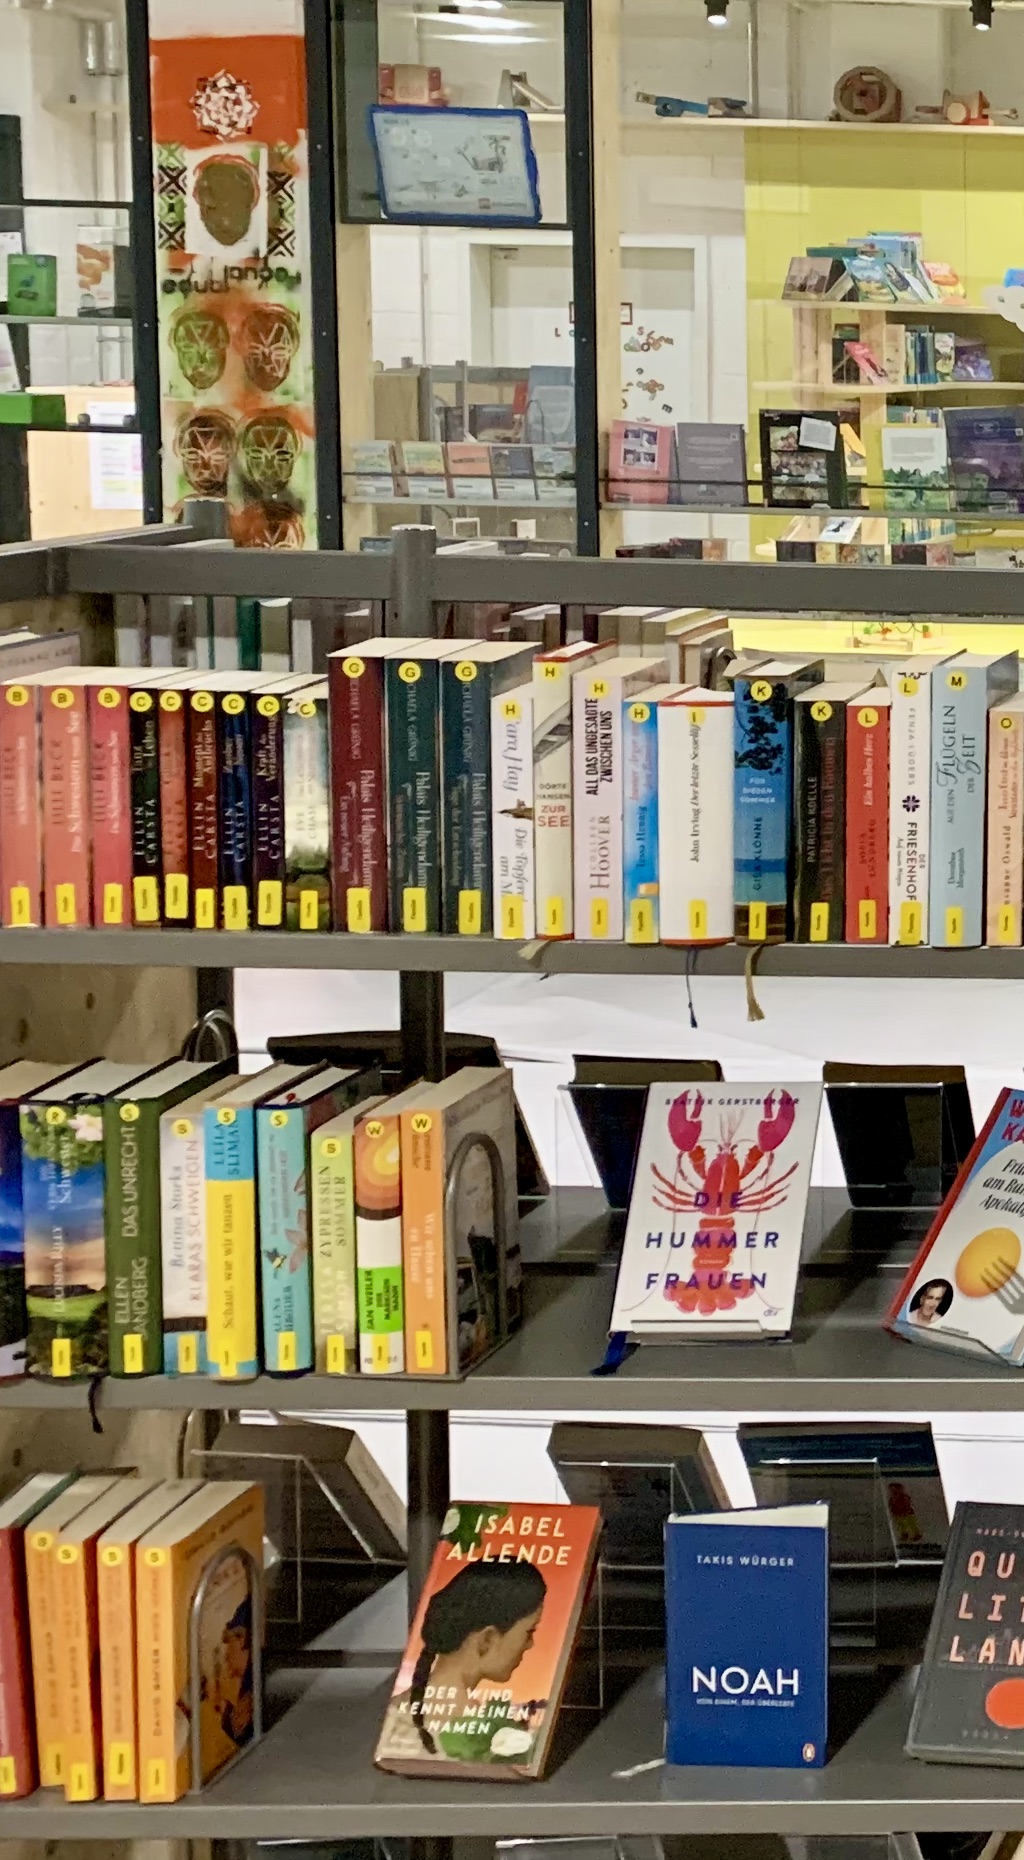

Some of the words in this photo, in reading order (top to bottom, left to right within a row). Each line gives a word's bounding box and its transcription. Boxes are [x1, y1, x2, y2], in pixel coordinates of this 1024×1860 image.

[756, 686, 766, 696] K
[904, 683, 912, 694] L
[950, 676, 962, 687] M
[600, 711, 613, 731] UNS
[816, 706, 826, 716] K
[864, 714, 872, 724] L
[584, 698, 598, 754] UNGESAGTE
[935, 705, 957, 787] FLÜGELN
[954, 733, 981, 774] ZEIT
[586, 757, 598, 775] DAS
[600, 733, 613, 783] ZWISCHEN
[585, 780, 598, 795] ALL
[540, 805, 565, 813] ZUR
[145, 798, 156, 864] CARSTA
[205, 794, 216, 859] CARSTA
[269, 795, 280, 859] CARSTA
[538, 815, 570, 828] SEE
[690, 808, 701, 836] Irving
[690, 839, 700, 862] John
[807, 817, 817, 862] PATRICIA
[589, 815, 610, 889] HOOVER
[906, 822, 918, 901] FRIESENHOF
[413, 1115, 430, 1132] W
[120, 1125, 137, 1202] UNRECHT
[186, 1140, 199, 1237] SCHWEIGEN
[983, 1176, 1002, 1191] am
[694, 1191, 743, 1208] DIE
[121, 1206, 138, 1238] DAS
[318, 1166, 332, 1257] ZYPRESSEN
[333, 1176, 347, 1247] SOMMER
[645, 1231, 780, 1249] HUMMER
[187, 1242, 202, 1301] KLARAS
[224, 1260, 234, 1281] wie
[645, 1272, 767, 1290] FRAUEN
[114, 1277, 130, 1324] ELLEN
[474, 1513, 565, 1537] ISABEL
[446, 1542, 572, 1566] ALLENDE
[697, 1555, 734, 1566] TAKIS
[740, 1554, 794, 1567] WÜRGER
[692, 1666, 800, 1696] NOAH
[424, 1686, 457, 1700] DER
[466, 1687, 513, 1701] WIND
[397, 1702, 456, 1716] KENNT
[462, 1704, 530, 1720] MEINEN
[428, 1720, 491, 1735] NAMEN
